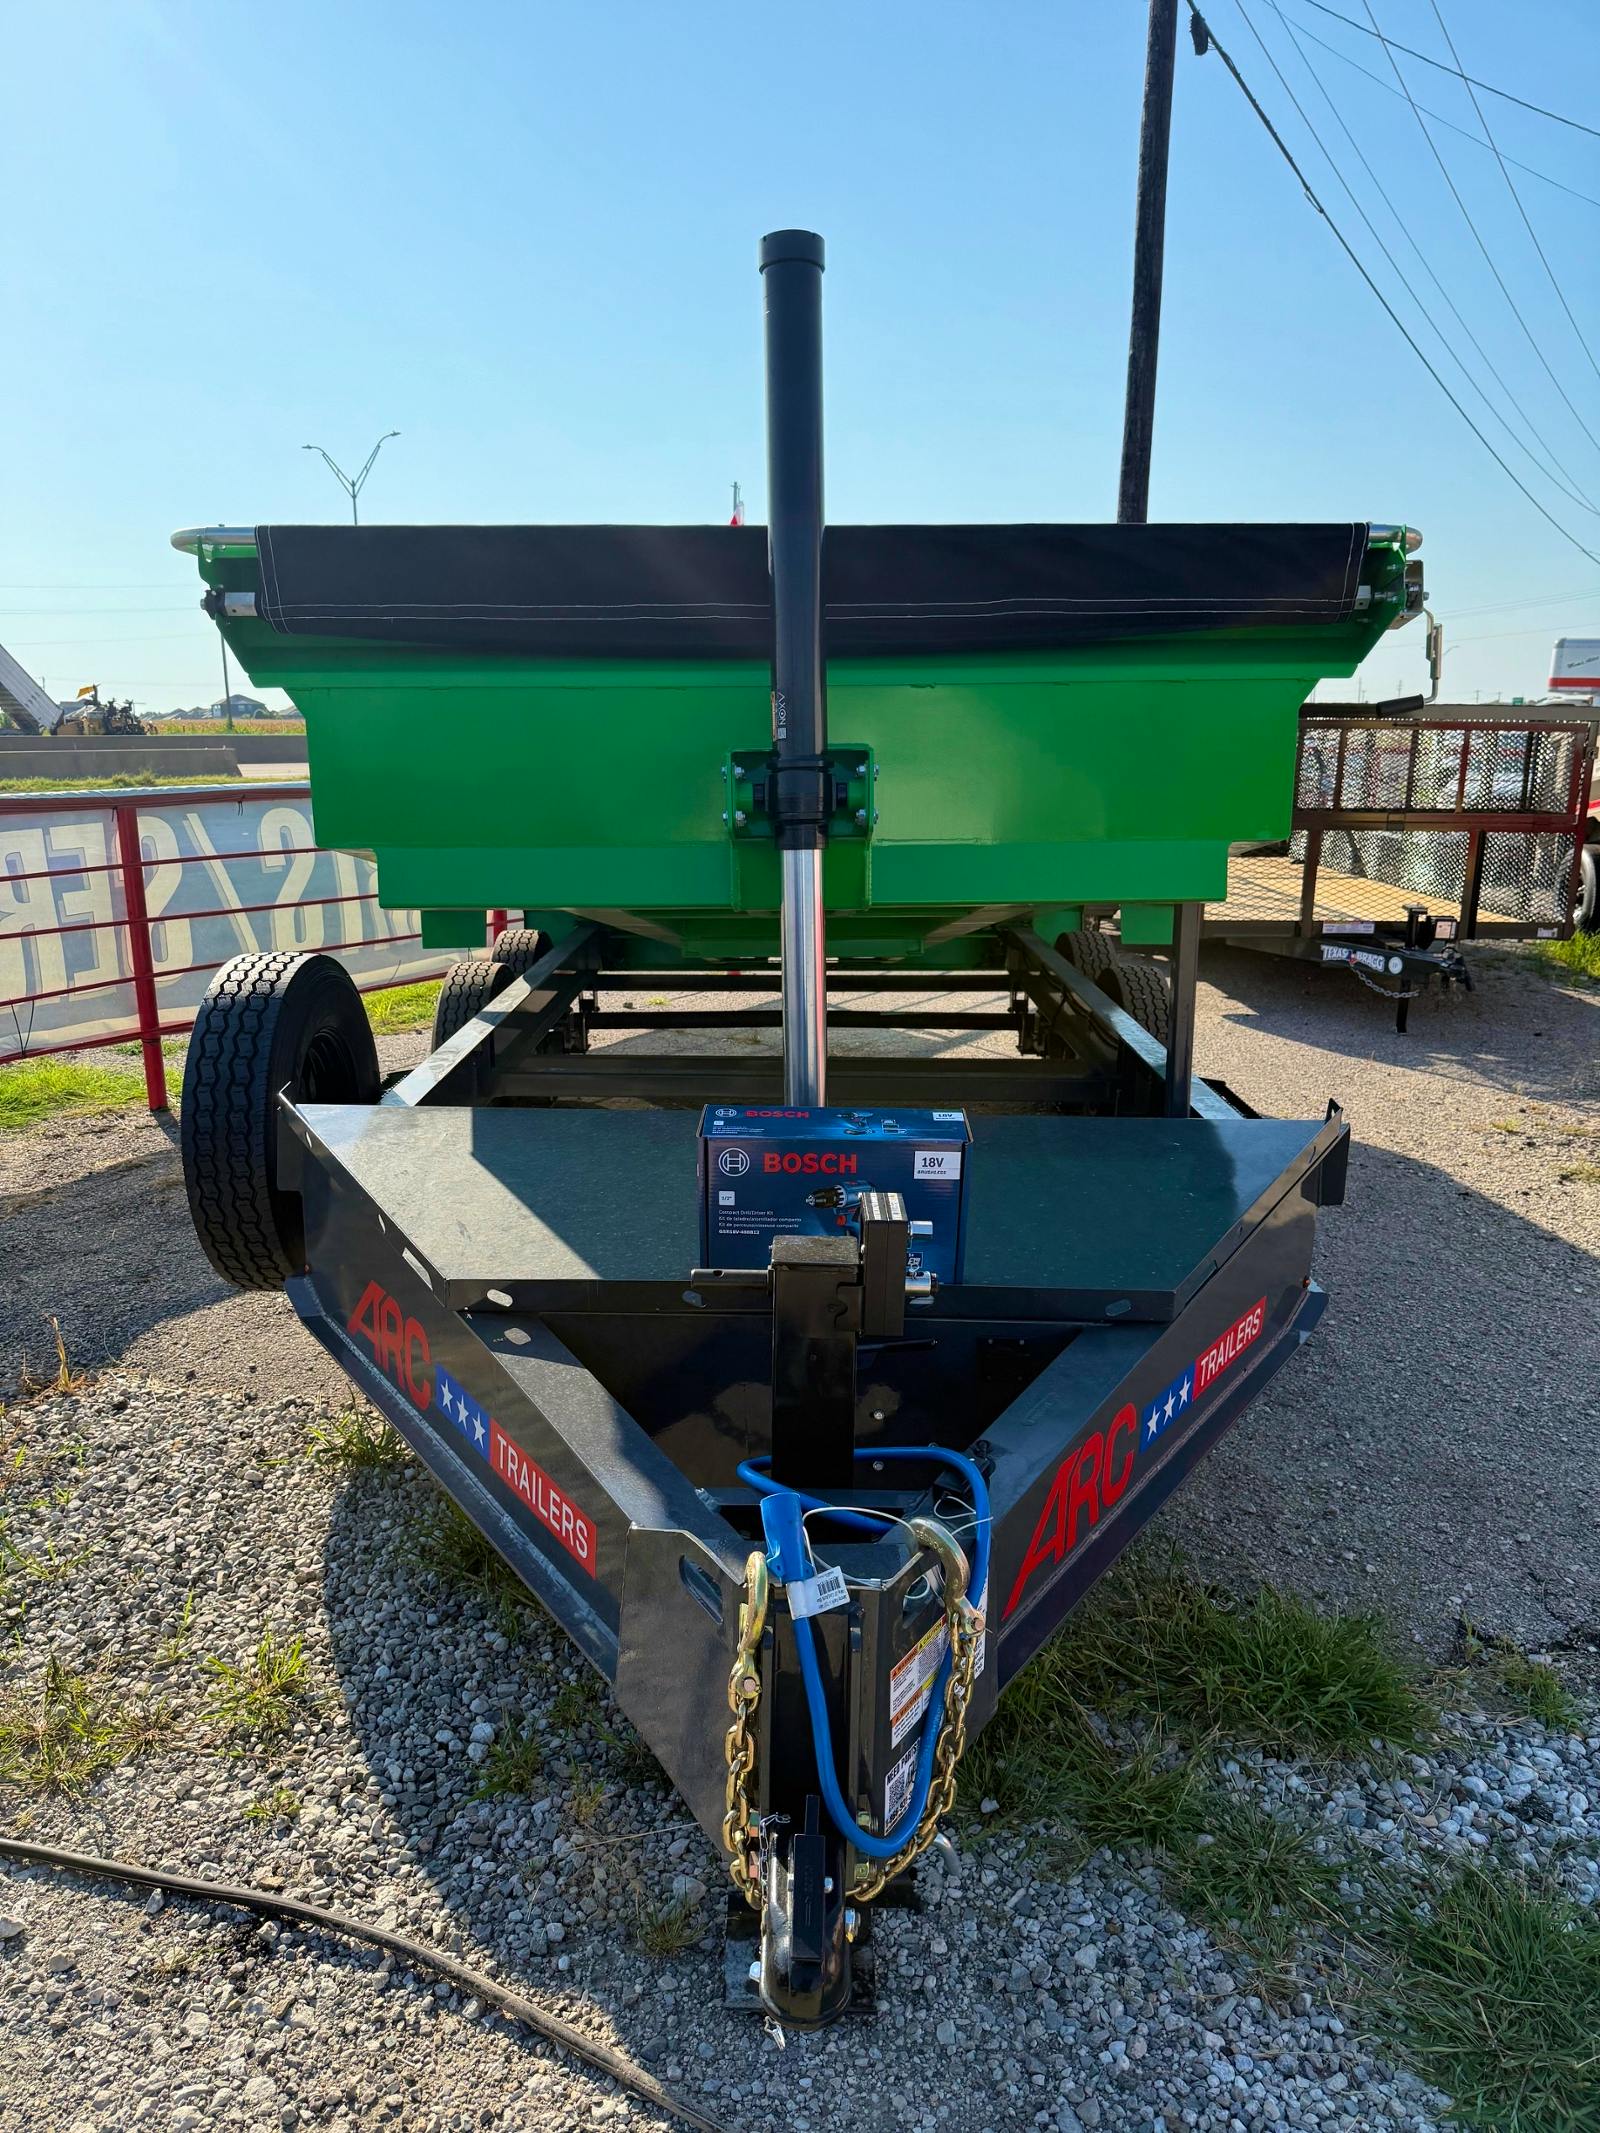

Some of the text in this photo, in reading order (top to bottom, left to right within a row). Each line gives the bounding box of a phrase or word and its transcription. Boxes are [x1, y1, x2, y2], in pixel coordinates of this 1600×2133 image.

[1321, 945, 1349, 961] TEXAS
[1356, 951, 1385, 972] BRAGG
[745, 1110, 810, 1119] BOSCH
[763, 1153, 858, 1174] BOSCH
[922, 1157, 944, 1168] 18V
[347, 1279, 588, 1560] ARC TRAILERS
[1001, 1308, 1261, 1622] ARC TRAILERS
